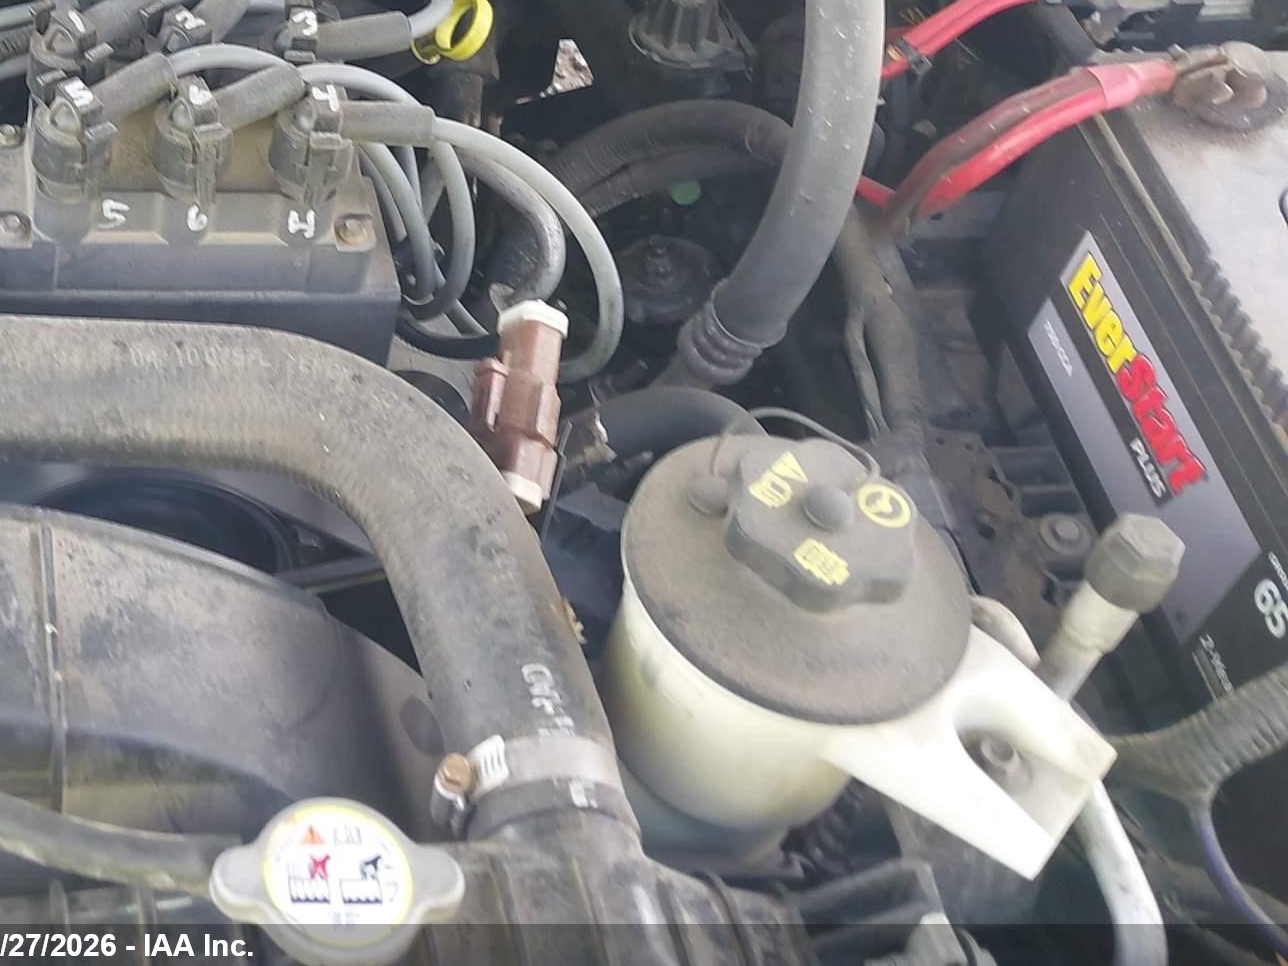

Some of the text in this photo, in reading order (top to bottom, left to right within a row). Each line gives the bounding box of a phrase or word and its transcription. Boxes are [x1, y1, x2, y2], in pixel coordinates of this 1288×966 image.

[292, 8, 318, 35] 3
[311, 84, 341, 112] 4
[98, 199, 130, 229] 5
[187, 204, 208, 232] 6
[288, 209, 315, 239] 4
[1129, 437, 1167, 498] PLUS
[1254, 578, 1288, 638] 65
